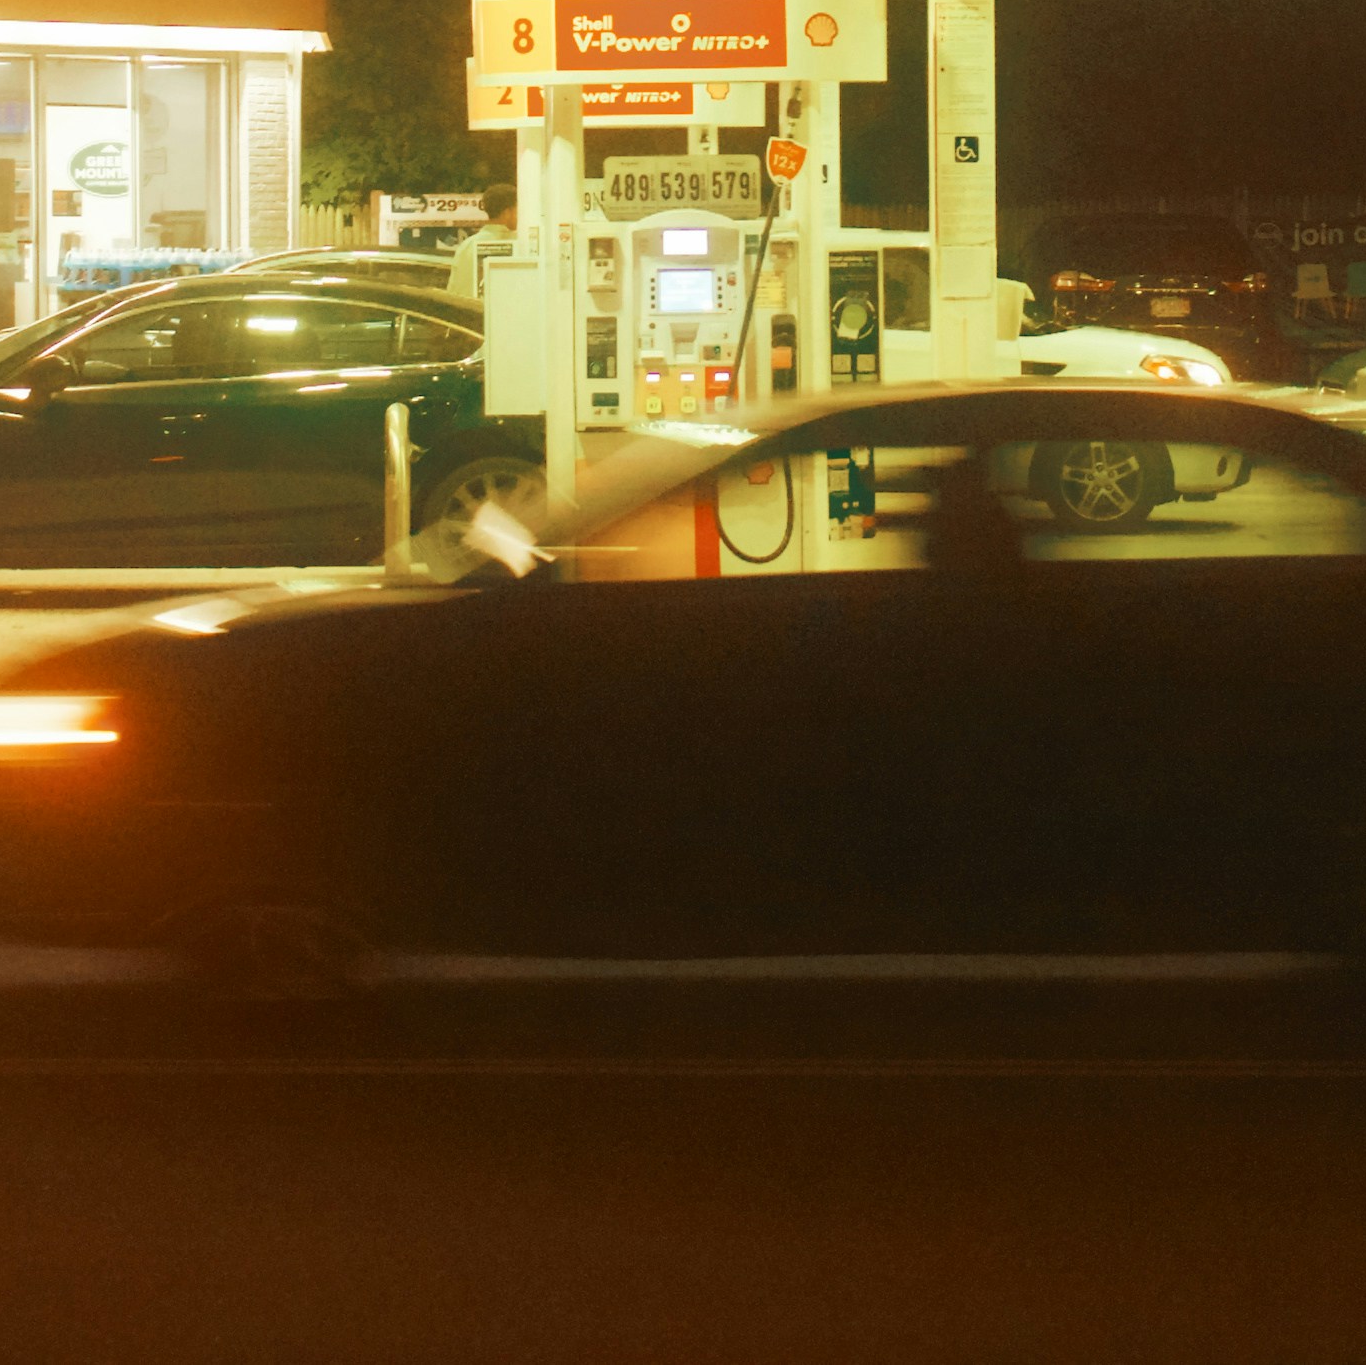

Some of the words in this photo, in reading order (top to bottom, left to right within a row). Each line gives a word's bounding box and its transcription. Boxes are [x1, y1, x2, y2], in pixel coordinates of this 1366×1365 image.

[512, 17, 535, 54] 8
[572, 14, 613, 31] Shell
[572, 32, 683, 53] V-Power
[74, 167, 128, 180] MOUNT
[86, 156, 122, 167] GREE
[610, 173, 651, 202] 489
[660, 172, 701, 201] 539
[712, 171, 751, 200] 579
[1291, 222, 1345, 251] join
